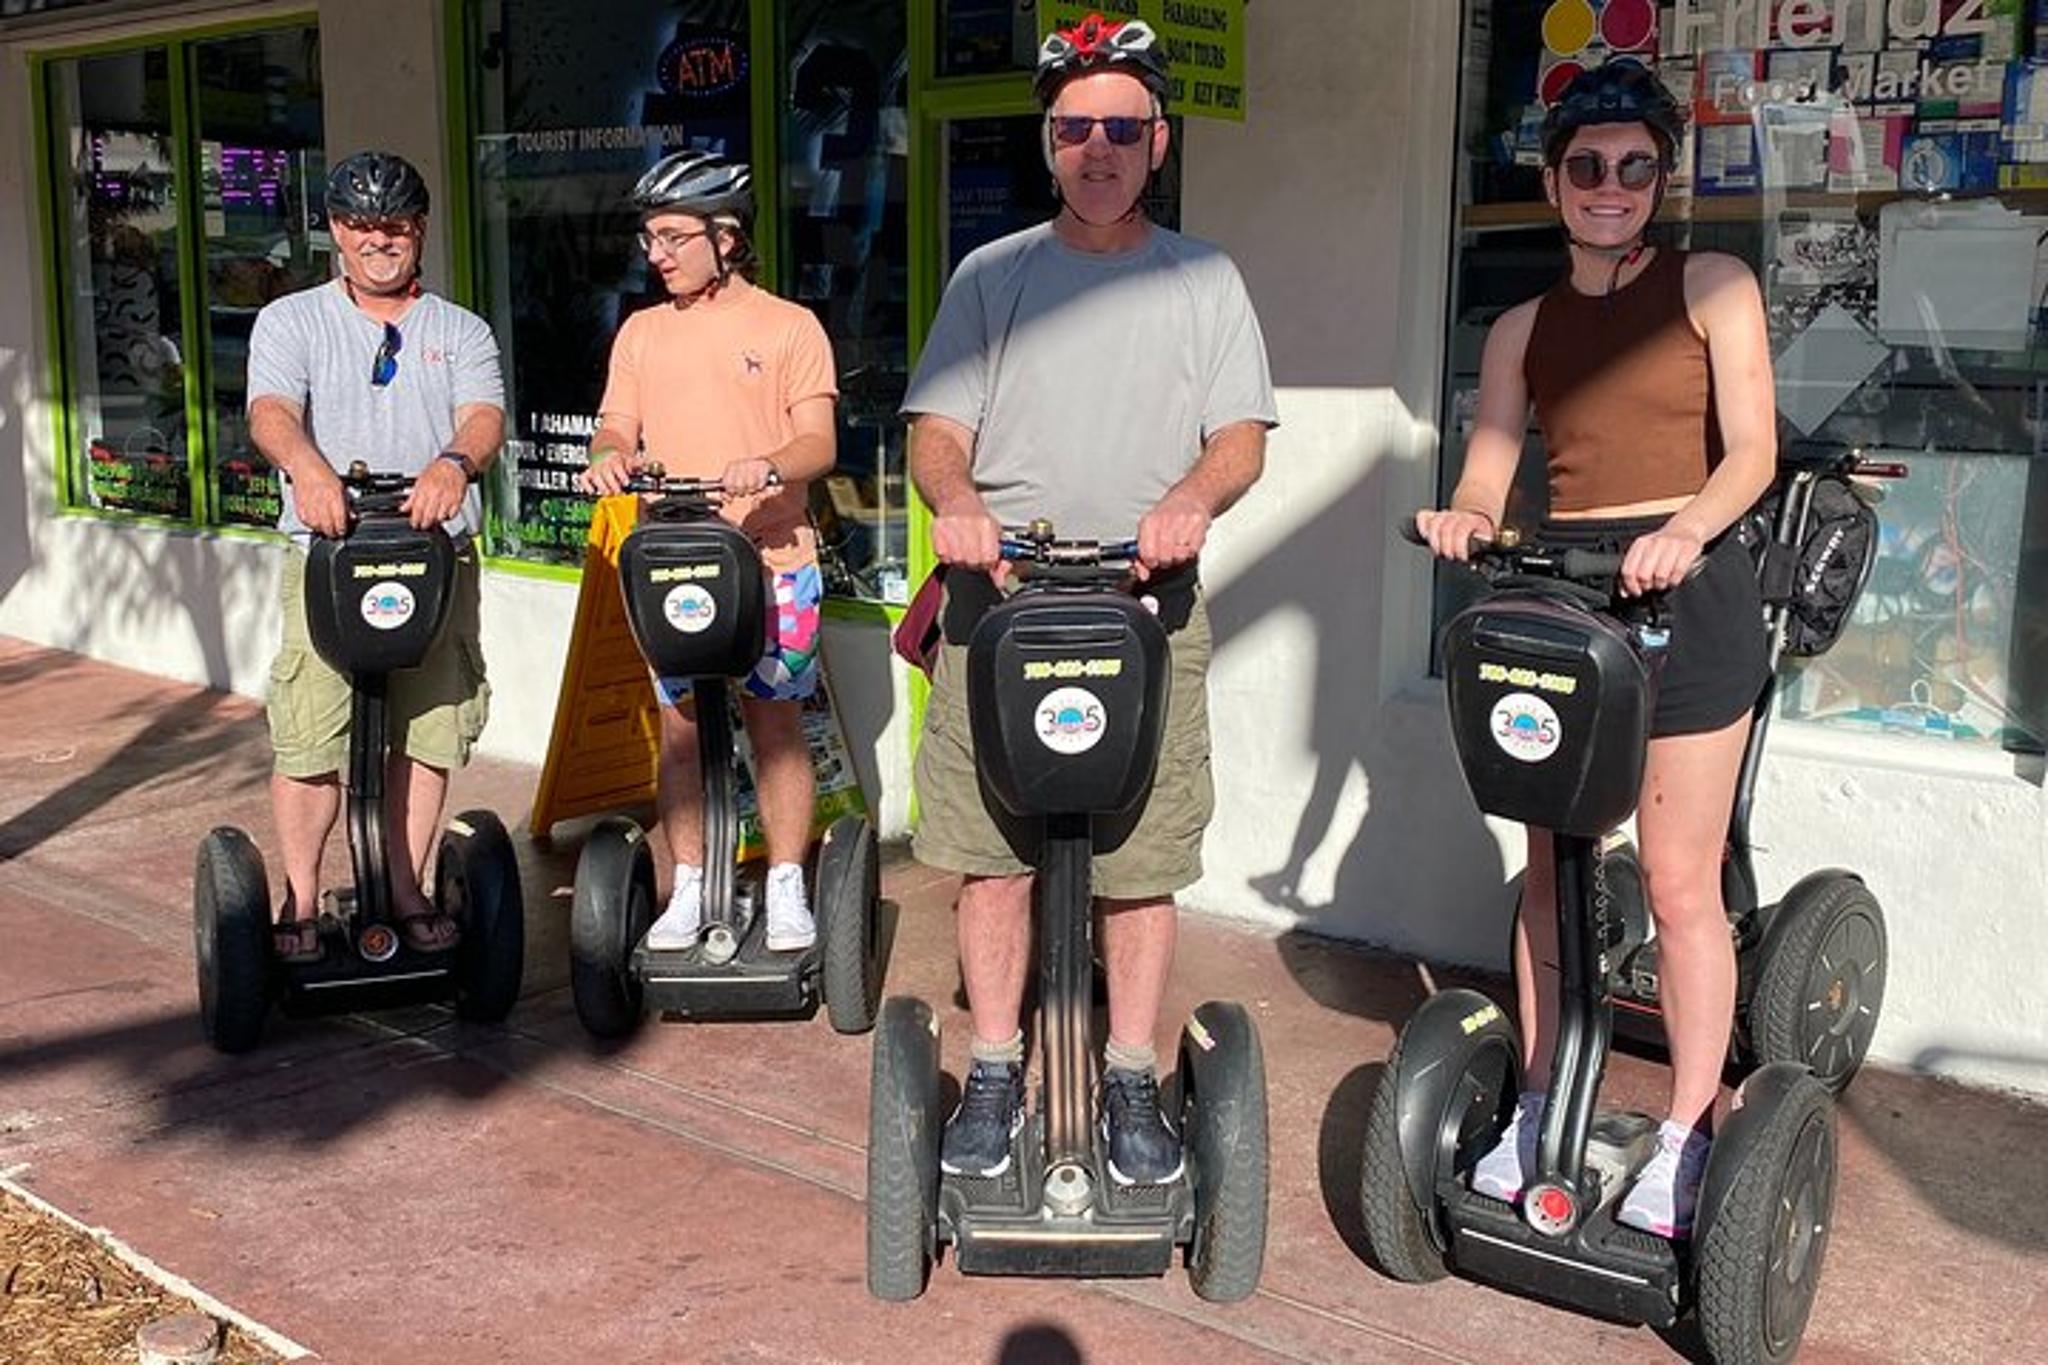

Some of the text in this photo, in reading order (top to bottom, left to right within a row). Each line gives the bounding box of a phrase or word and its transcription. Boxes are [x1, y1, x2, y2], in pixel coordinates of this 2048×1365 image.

[678, 44, 735, 92] ATM
[516, 125, 684, 151] TOURIST INFORMATION
